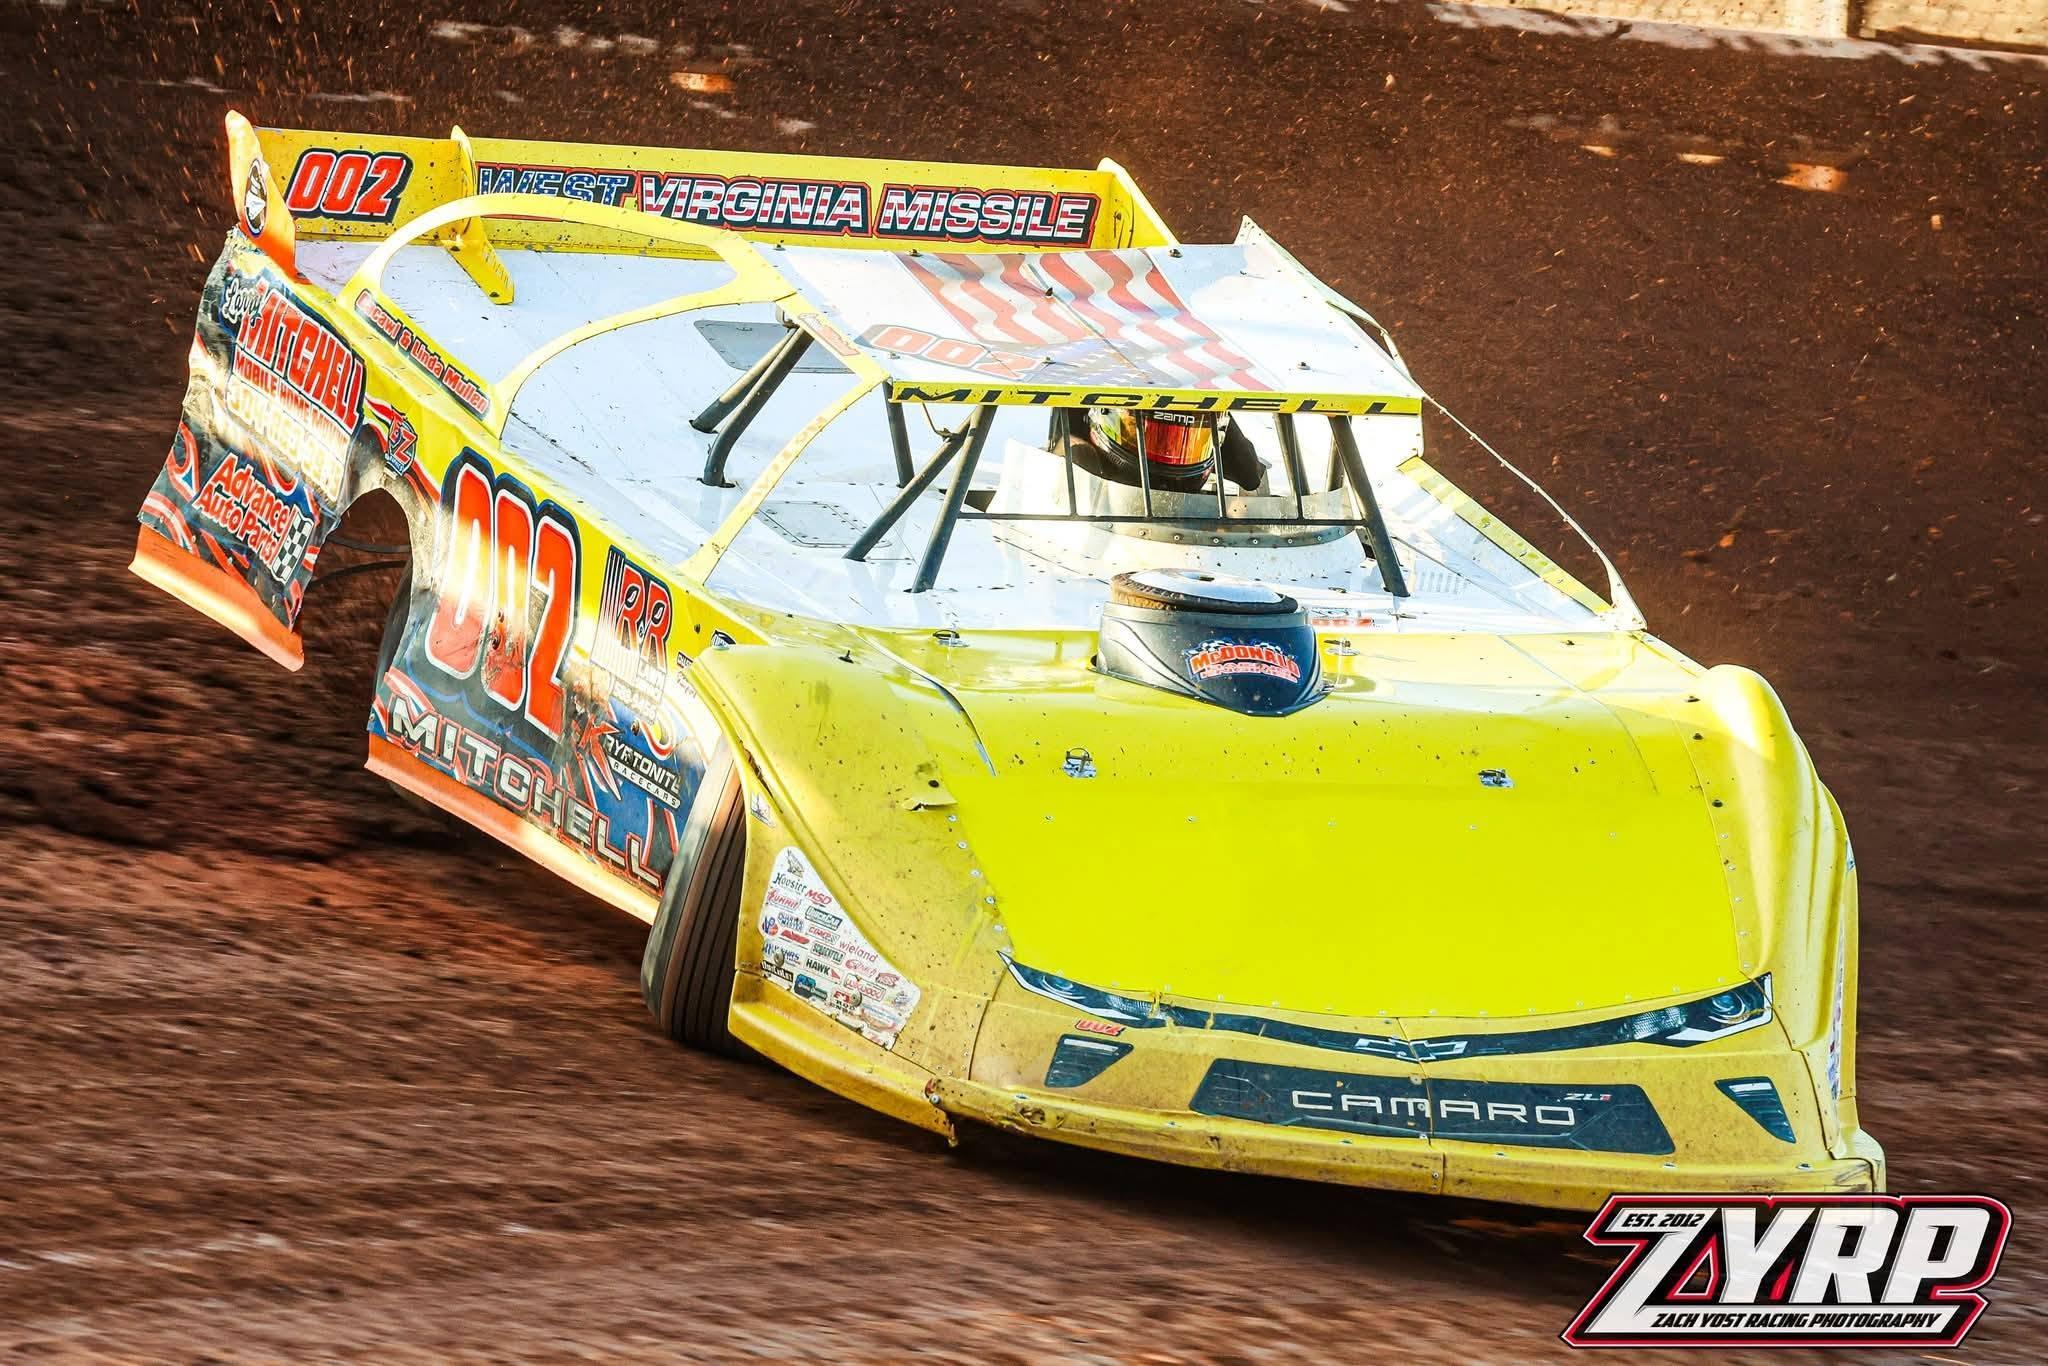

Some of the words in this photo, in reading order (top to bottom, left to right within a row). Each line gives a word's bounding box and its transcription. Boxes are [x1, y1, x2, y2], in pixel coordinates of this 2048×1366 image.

[288, 151, 408, 219] 002
[479, 167, 630, 207] WEST
[640, 175, 867, 230] VIRGINIA
[878, 188, 1093, 239] MISSILE
[234, 350, 281, 398] MOBILE
[236, 288, 364, 430] MITCHELL
[398, 329, 413, 351] &
[410, 338, 445, 379] Linda
[441, 366, 489, 415] Mullen
[870, 326, 1043, 381] 002
[896, 386, 1418, 416] MITCHELL
[1153, 410, 1196, 426] zamp
[209, 452, 291, 538] Advance
[425, 462, 578, 743] 002
[390, 698, 666, 892] MITCHELL
[612, 761, 678, 806] RACECARS
[772, 872, 807, 893] Hoosier
[805, 889, 833, 905] MSD
[806, 958, 831, 975] HAWK
[840, 940, 879, 962] wieland
[1291, 1090, 1576, 1126] CAMARO
